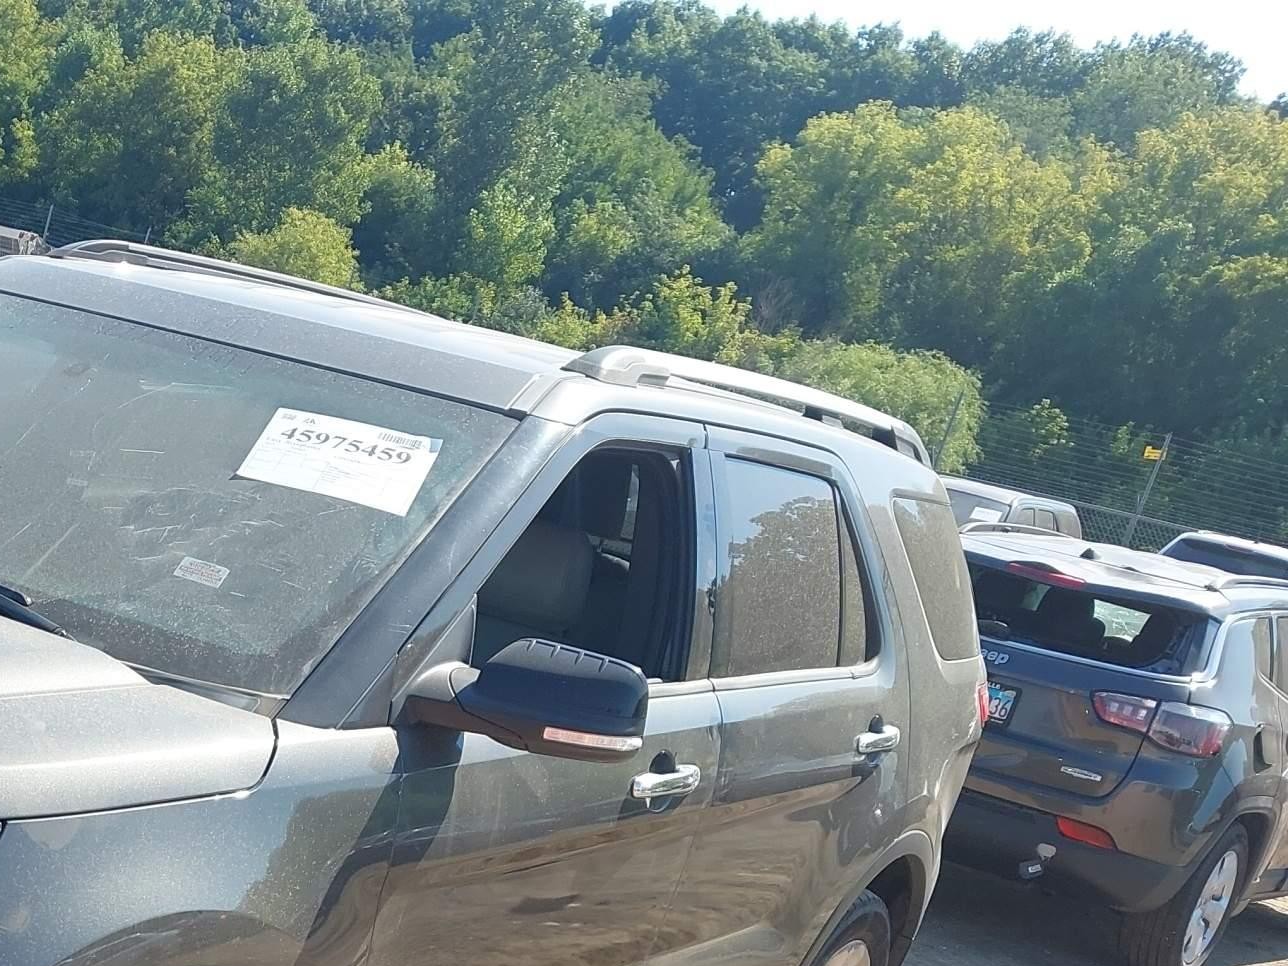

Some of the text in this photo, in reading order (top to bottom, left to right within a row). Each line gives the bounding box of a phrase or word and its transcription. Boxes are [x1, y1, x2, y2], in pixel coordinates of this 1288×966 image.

[281, 427, 412, 465] 45975459
[982, 649, 1009, 665] eep
[990, 697, 1011, 718] 36
